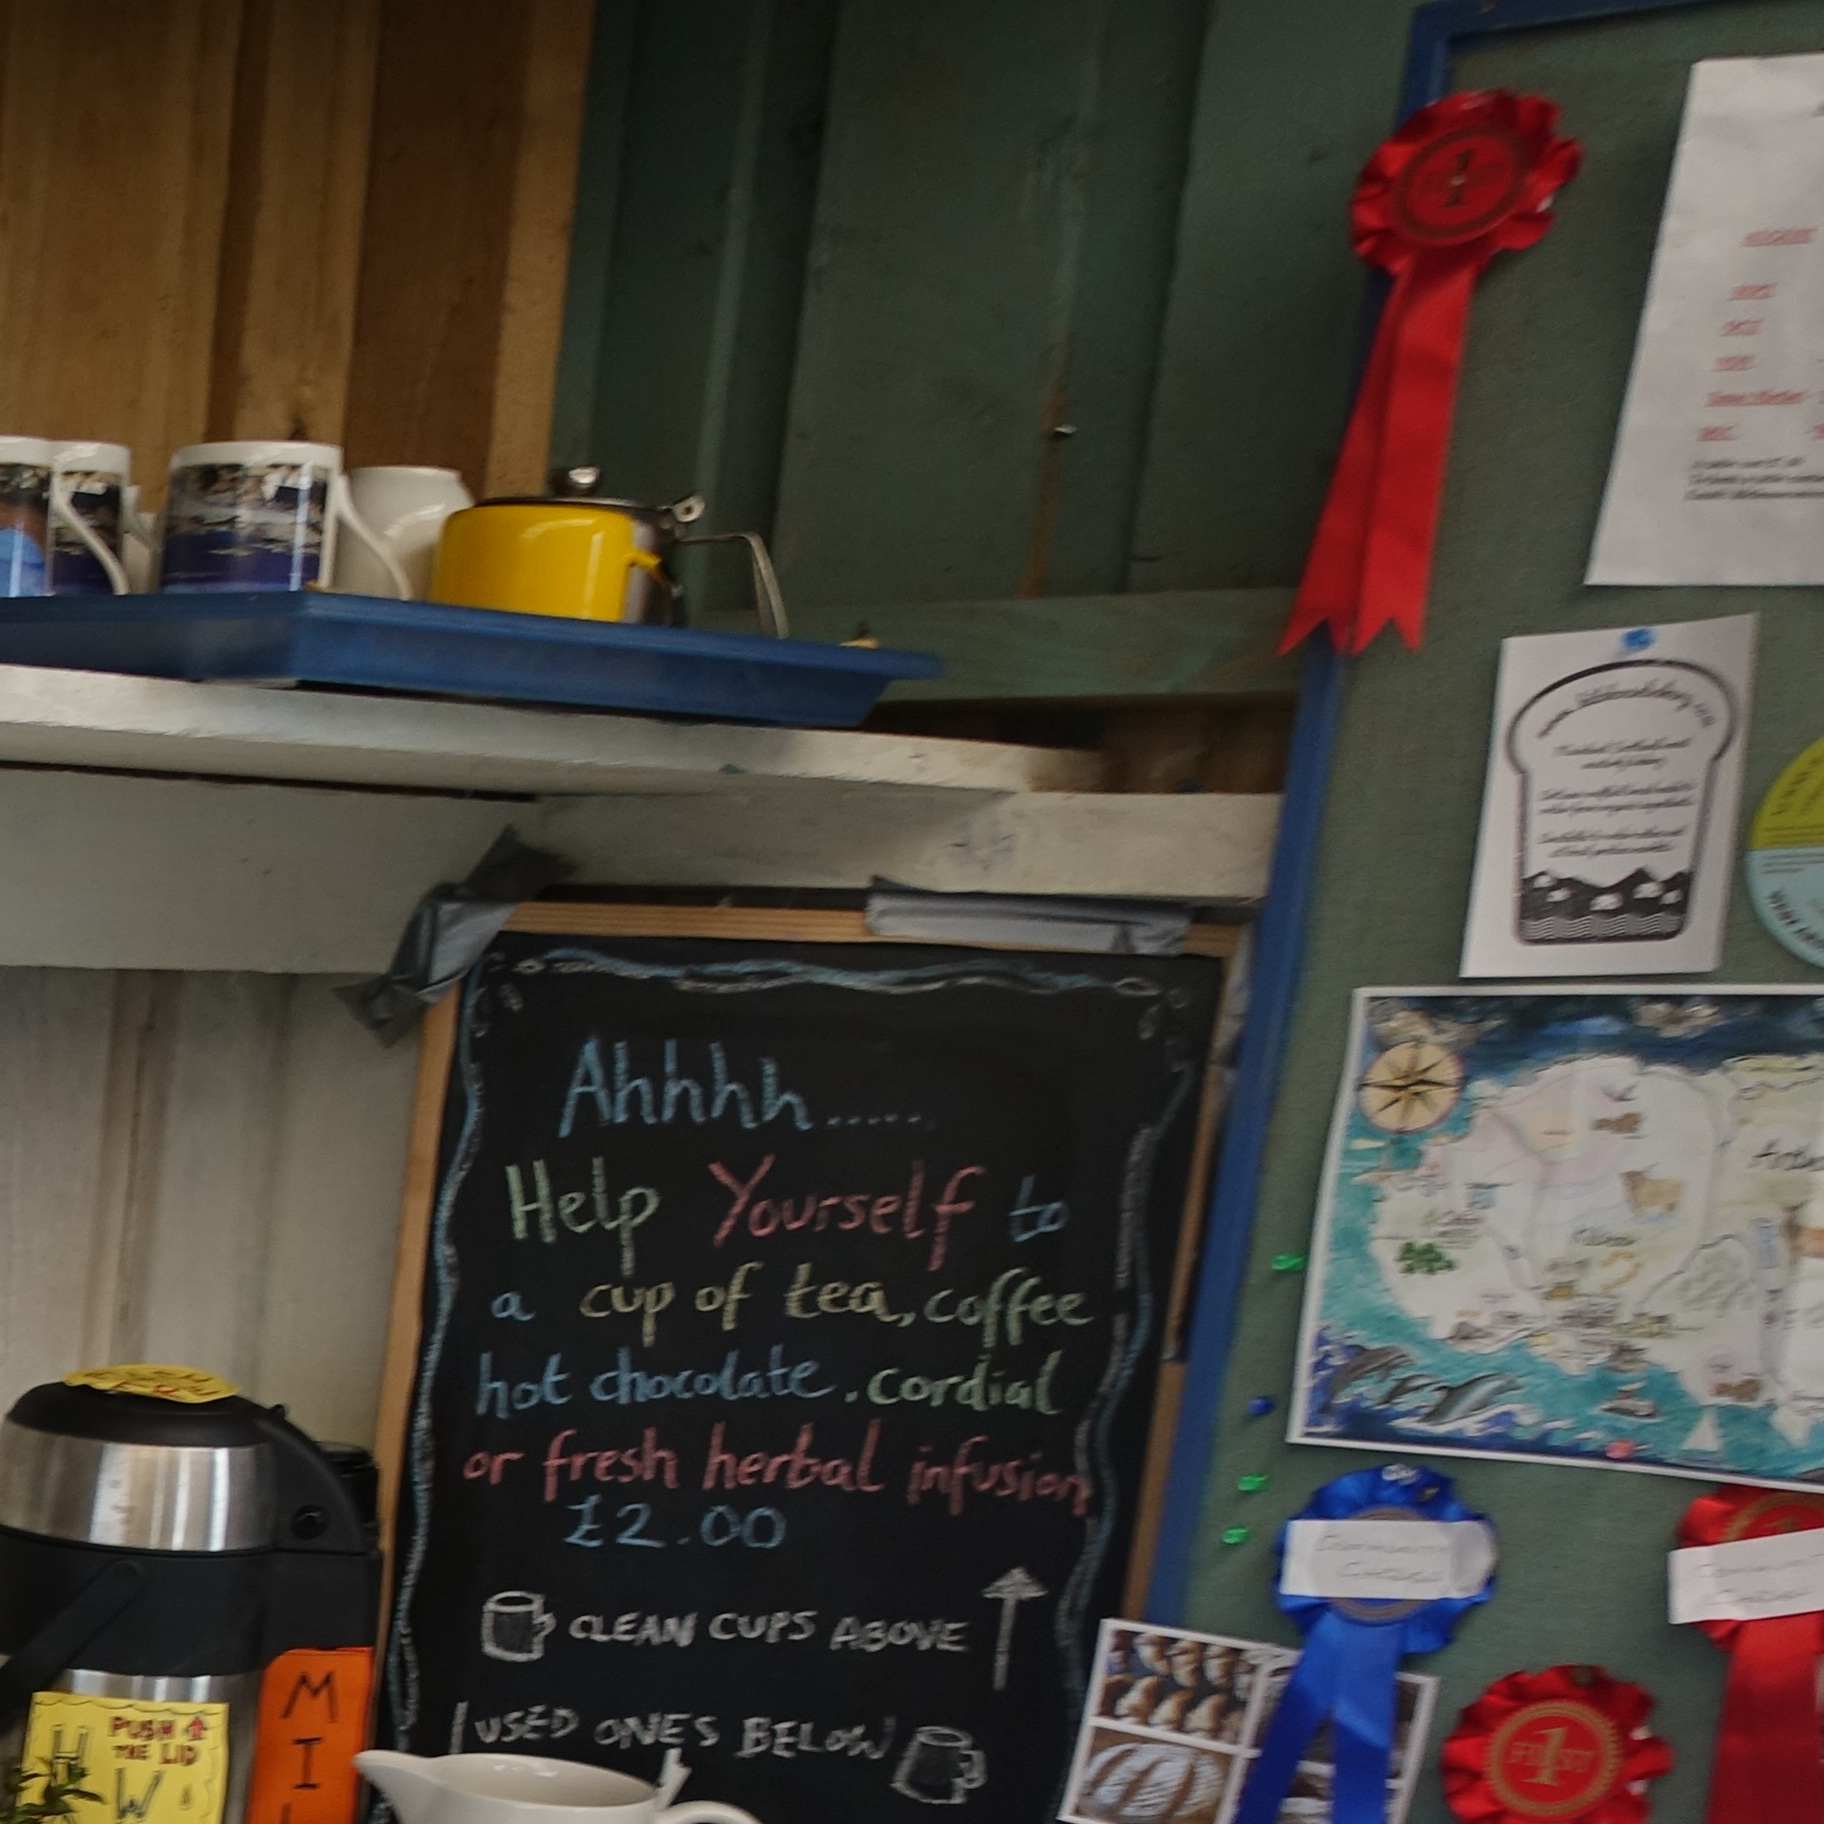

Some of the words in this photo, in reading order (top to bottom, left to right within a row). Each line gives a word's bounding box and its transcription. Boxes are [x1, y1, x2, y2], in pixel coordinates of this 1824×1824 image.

[504, 1155, 660, 1278] Help
[708, 1152, 986, 1271] Yourself
[1009, 1174, 1069, 1243] to
[490, 1286, 536, 1323] a
[578, 1280, 676, 1348] cup
[694, 1260, 766, 1332] of
[924, 1267, 1096, 1348] coffee
[477, 1350, 572, 1419] hot
[462, 1447, 524, 1484] or
[542, 1426, 682, 1503] fresh
[701, 1418, 887, 1495] herbal
[907, 1443, 1094, 1518] infusion
[563, 1494, 787, 1551] £2.00
[568, 1613, 698, 1649] CLEAN
[709, 1609, 817, 1644] CUPS
[829, 1611, 973, 1656] ABOVE
[110, 1715, 176, 1741] PUSH
[115, 1743, 150, 1761] THE
[159, 1743, 200, 1767] LID
[474, 1706, 580, 1746] USED
[594, 1710, 720, 1751] ONES
[738, 1714, 898, 1764] BELOW
